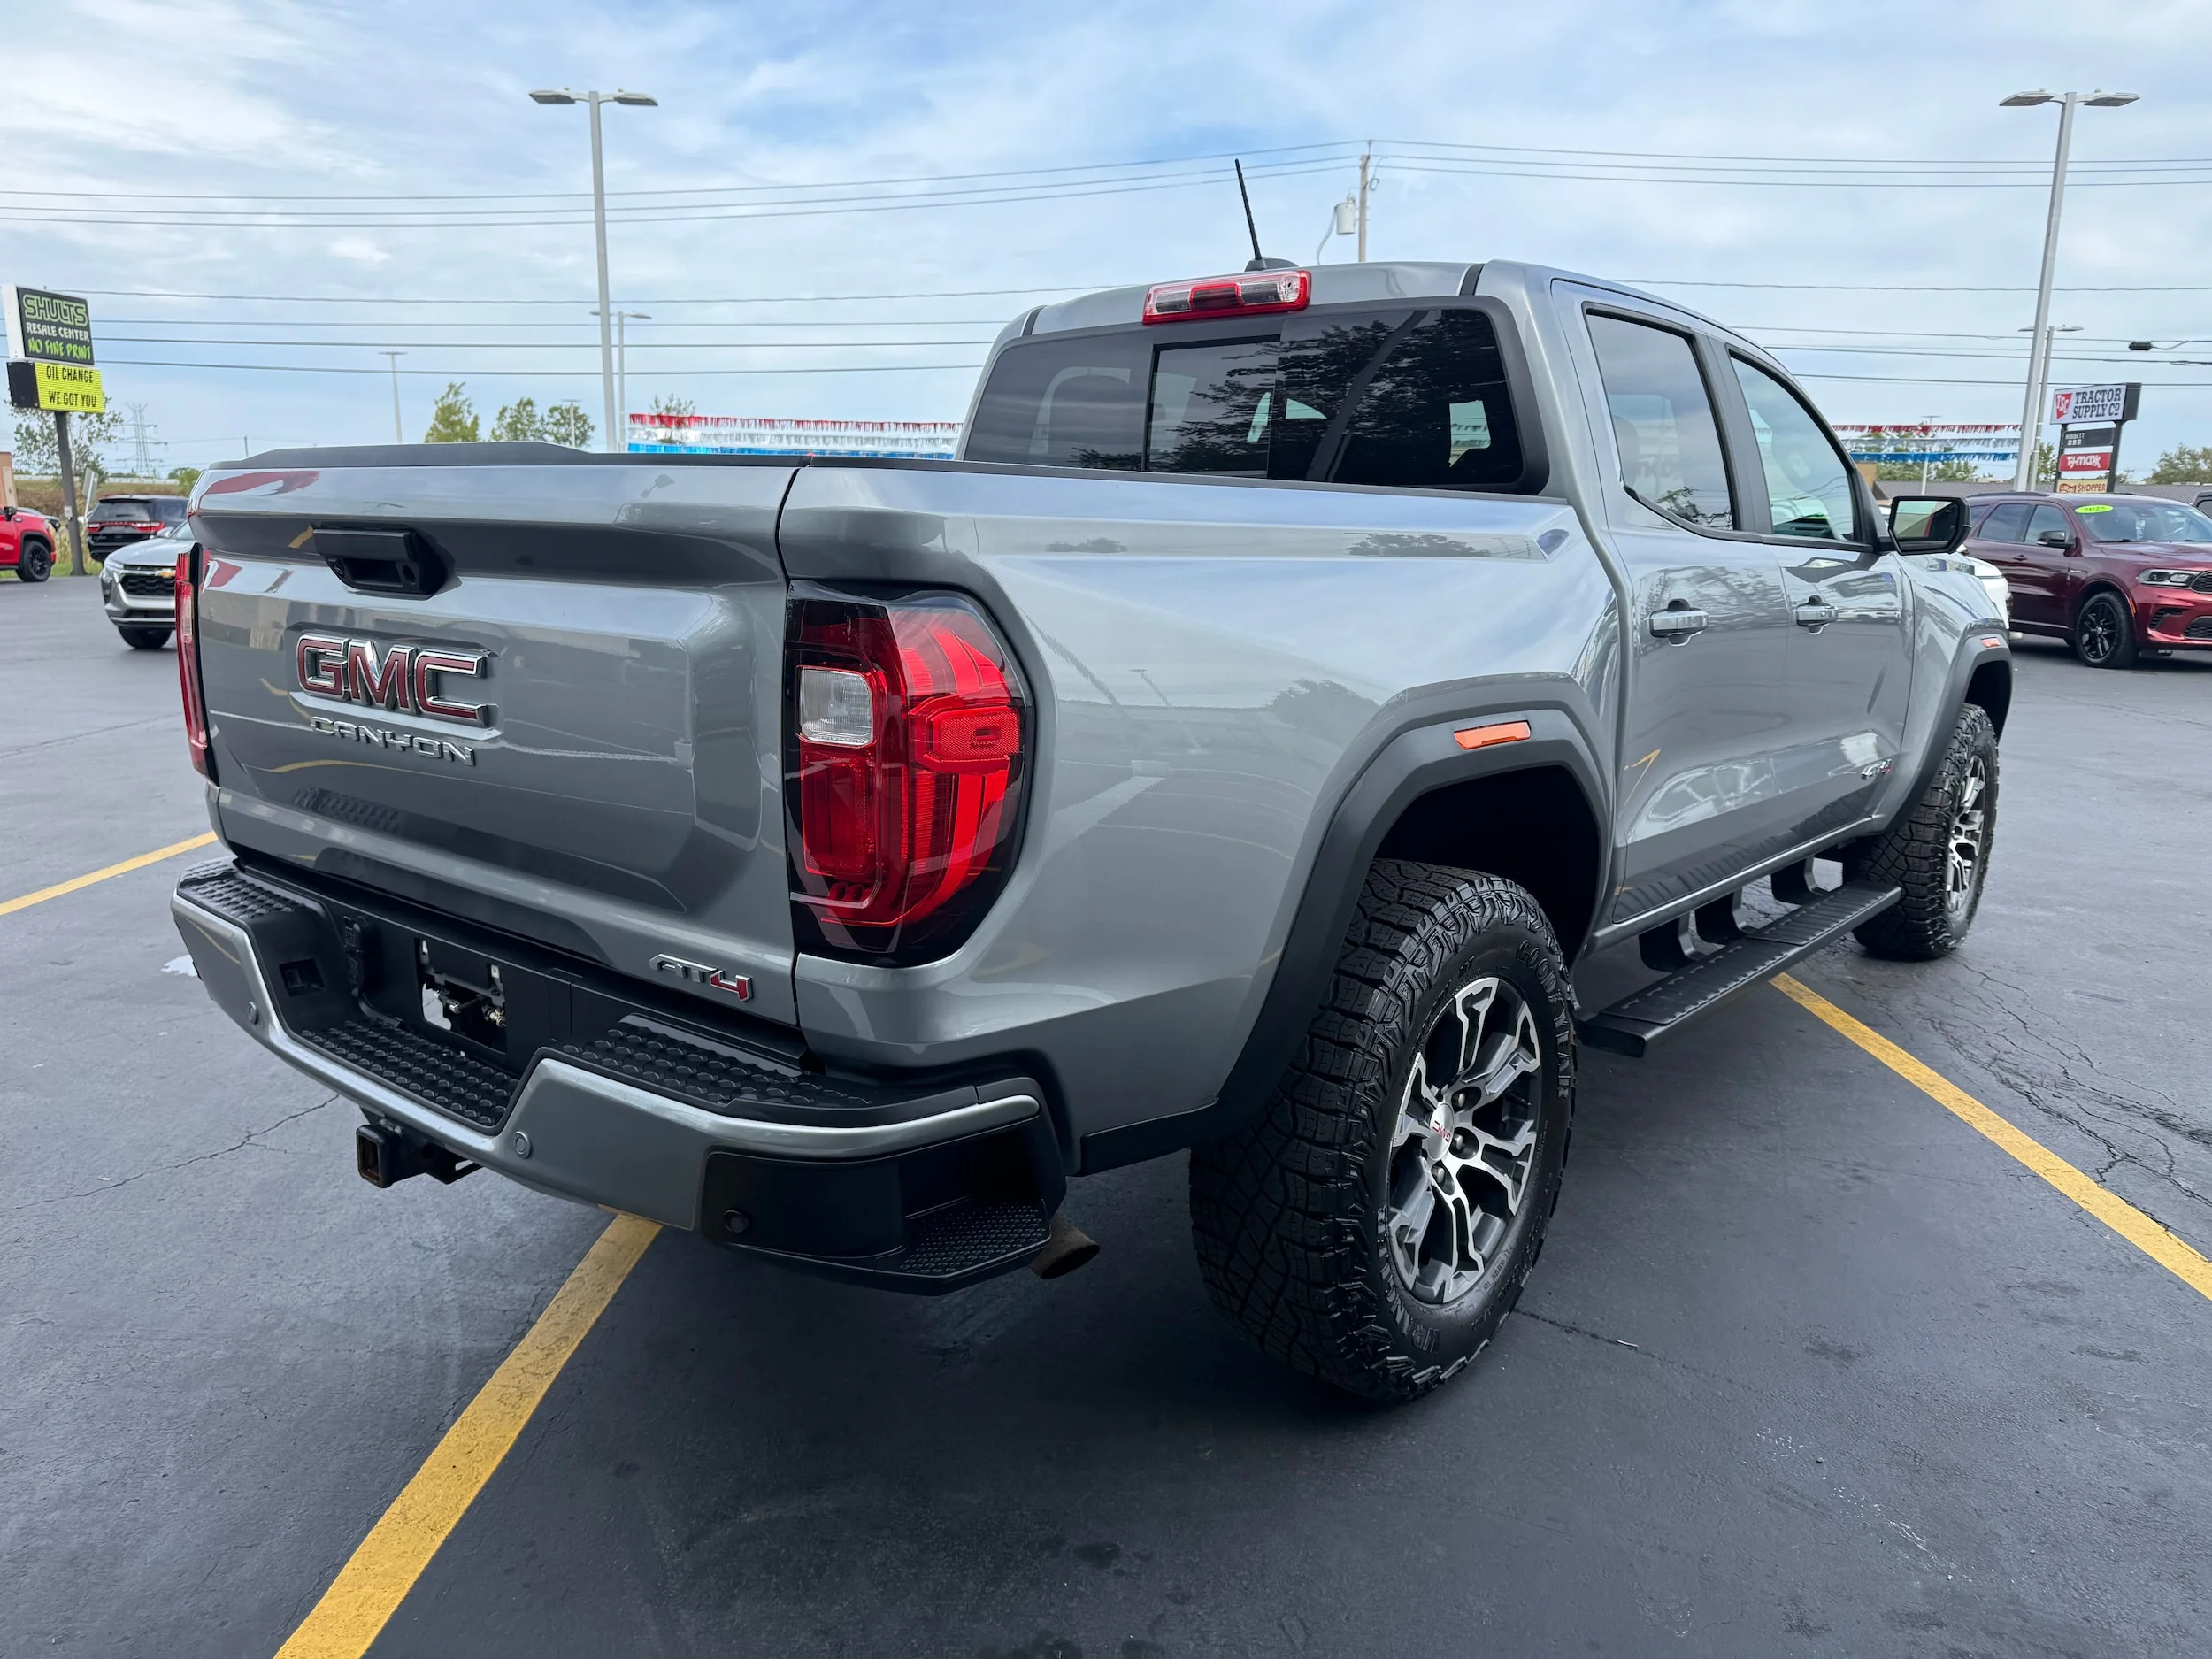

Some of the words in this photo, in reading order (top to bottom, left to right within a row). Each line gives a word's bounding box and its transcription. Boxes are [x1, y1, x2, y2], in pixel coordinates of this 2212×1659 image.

[23, 294, 88, 326] SHULTS
[26, 322, 57, 337] RESALE
[58, 326, 90, 342] CENTER
[28, 337, 42, 353] NO
[45, 340, 65, 357] FINE
[66, 343, 91, 360] PRINT
[46, 365, 59, 380] OIL
[62, 367, 94, 383] CHANGE
[49, 391, 60, 404] WE
[64, 392, 78, 406] GOT
[81, 394, 96, 408] YOU
[2075, 388, 2122, 404] TRACTOR
[2072, 404, 2107, 419] SUPPLY
[296, 633, 488, 726] GMC
[311, 716, 476, 766] CANYON
[649, 953, 754, 1002] AT4
[1516, 940, 1571, 1098] GOODYEAR
[1432, 1120, 1452, 1143] GMC
